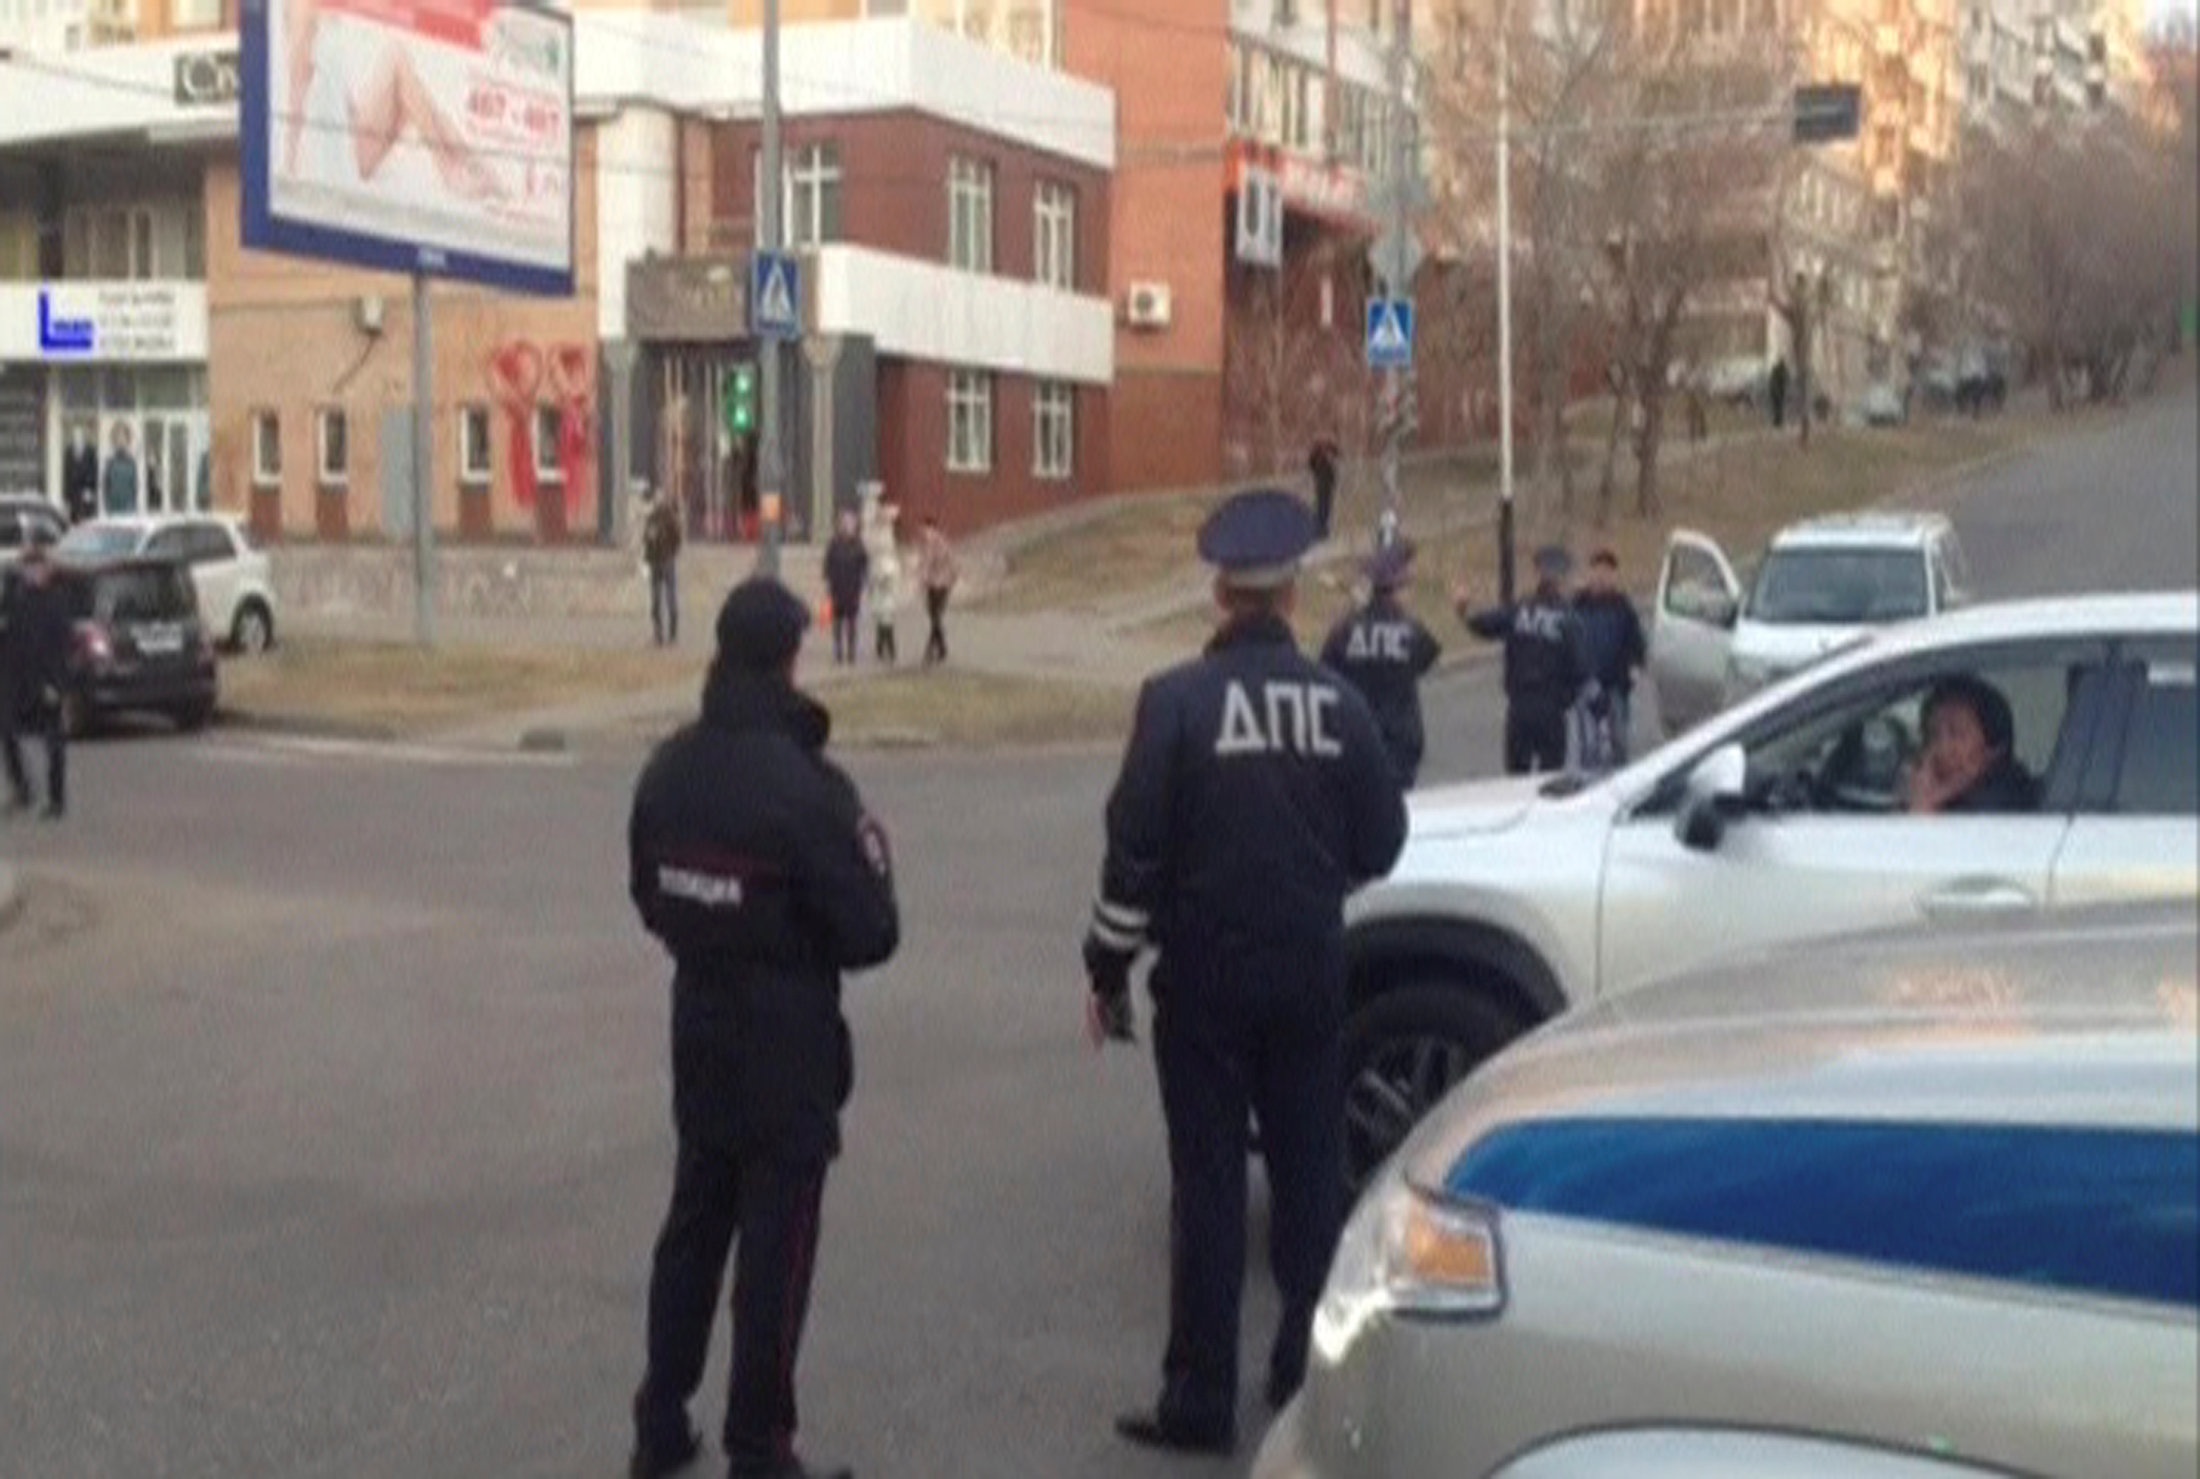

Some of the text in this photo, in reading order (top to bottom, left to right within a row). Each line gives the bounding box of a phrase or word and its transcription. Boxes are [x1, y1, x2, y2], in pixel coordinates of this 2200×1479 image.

[1345, 621, 1410, 662] ДПС
[1514, 606, 1565, 641] ДПС
[1214, 679, 1343, 757] ДПС
